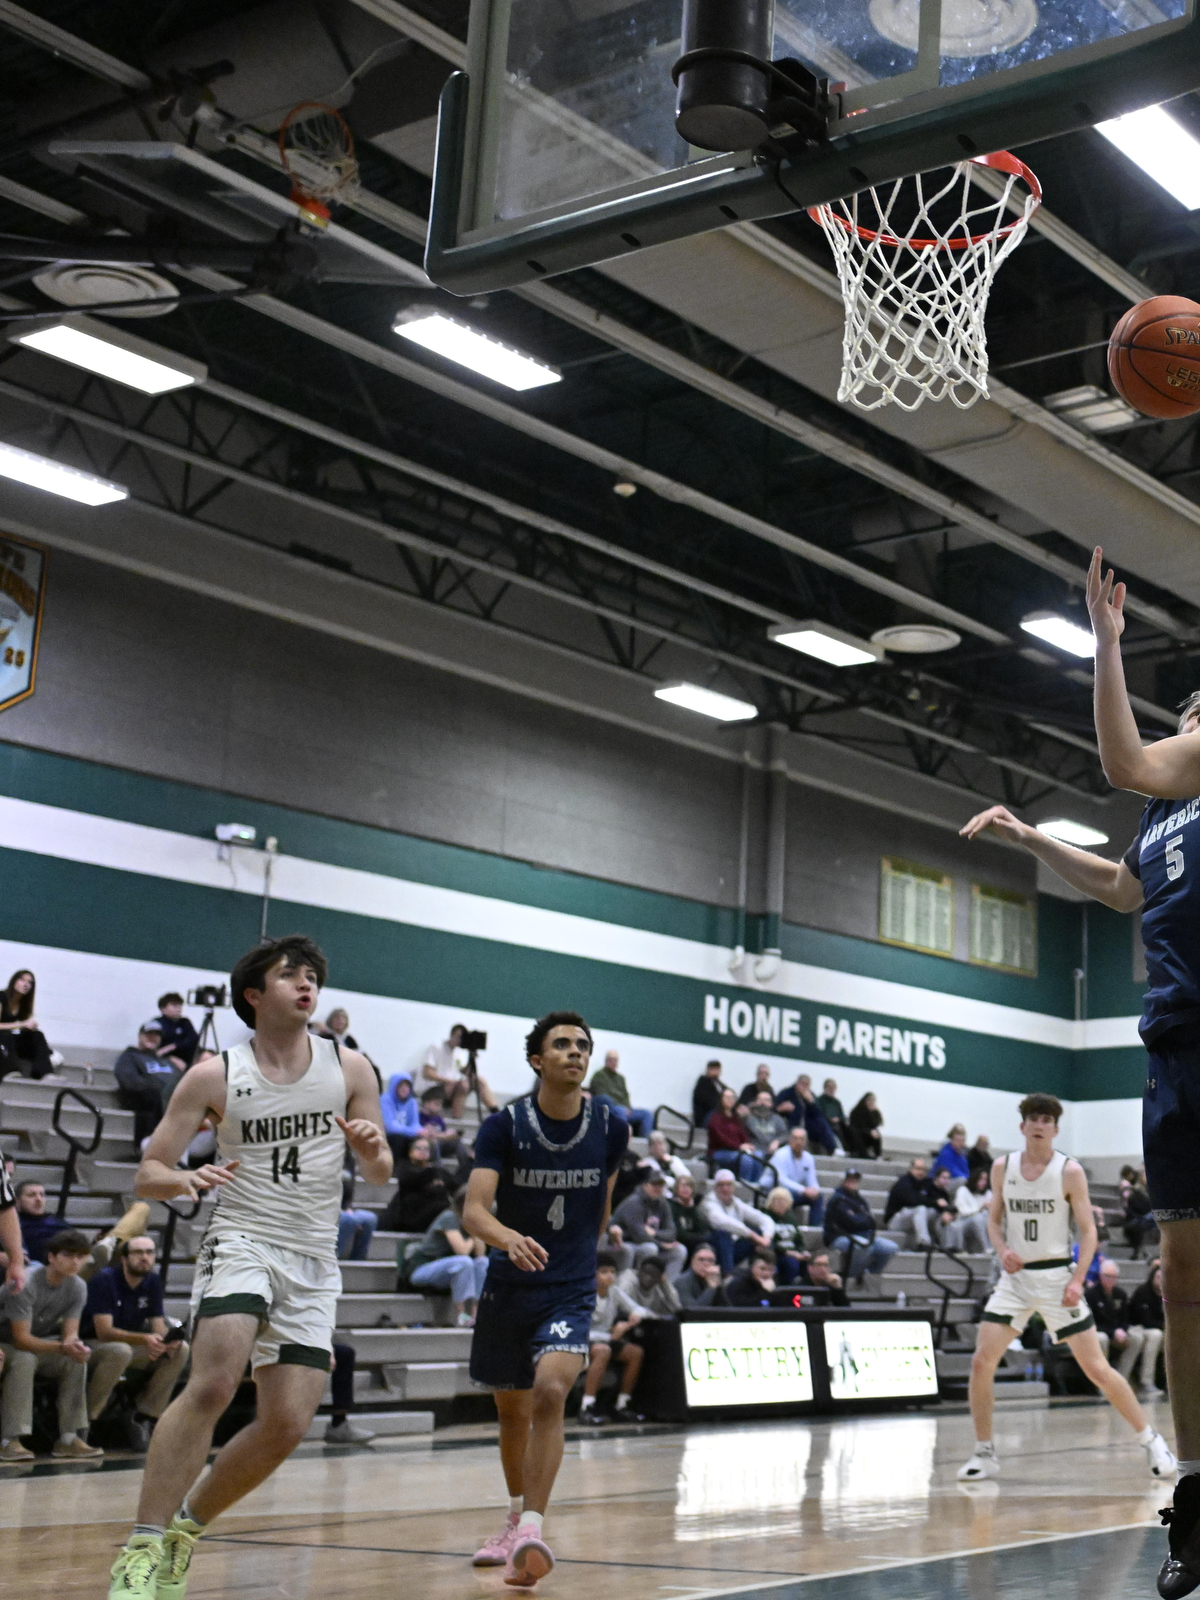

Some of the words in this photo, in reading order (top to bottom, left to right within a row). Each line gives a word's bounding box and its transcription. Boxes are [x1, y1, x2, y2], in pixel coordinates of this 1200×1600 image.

[1166, 834, 1185, 881] 5
[704, 995, 801, 1048] HOME
[816, 1015, 947, 1070] PARENTS
[242, 1111, 333, 1143] KNIGHTS
[271, 1146, 301, 1183] 14
[513, 1167, 601, 1189] MAVERICKS
[547, 1195, 565, 1230] 4
[1009, 1198, 1056, 1214] KNIGHTS
[1023, 1219, 1037, 1242] 10
[688, 1347, 804, 1381] CENTURY
